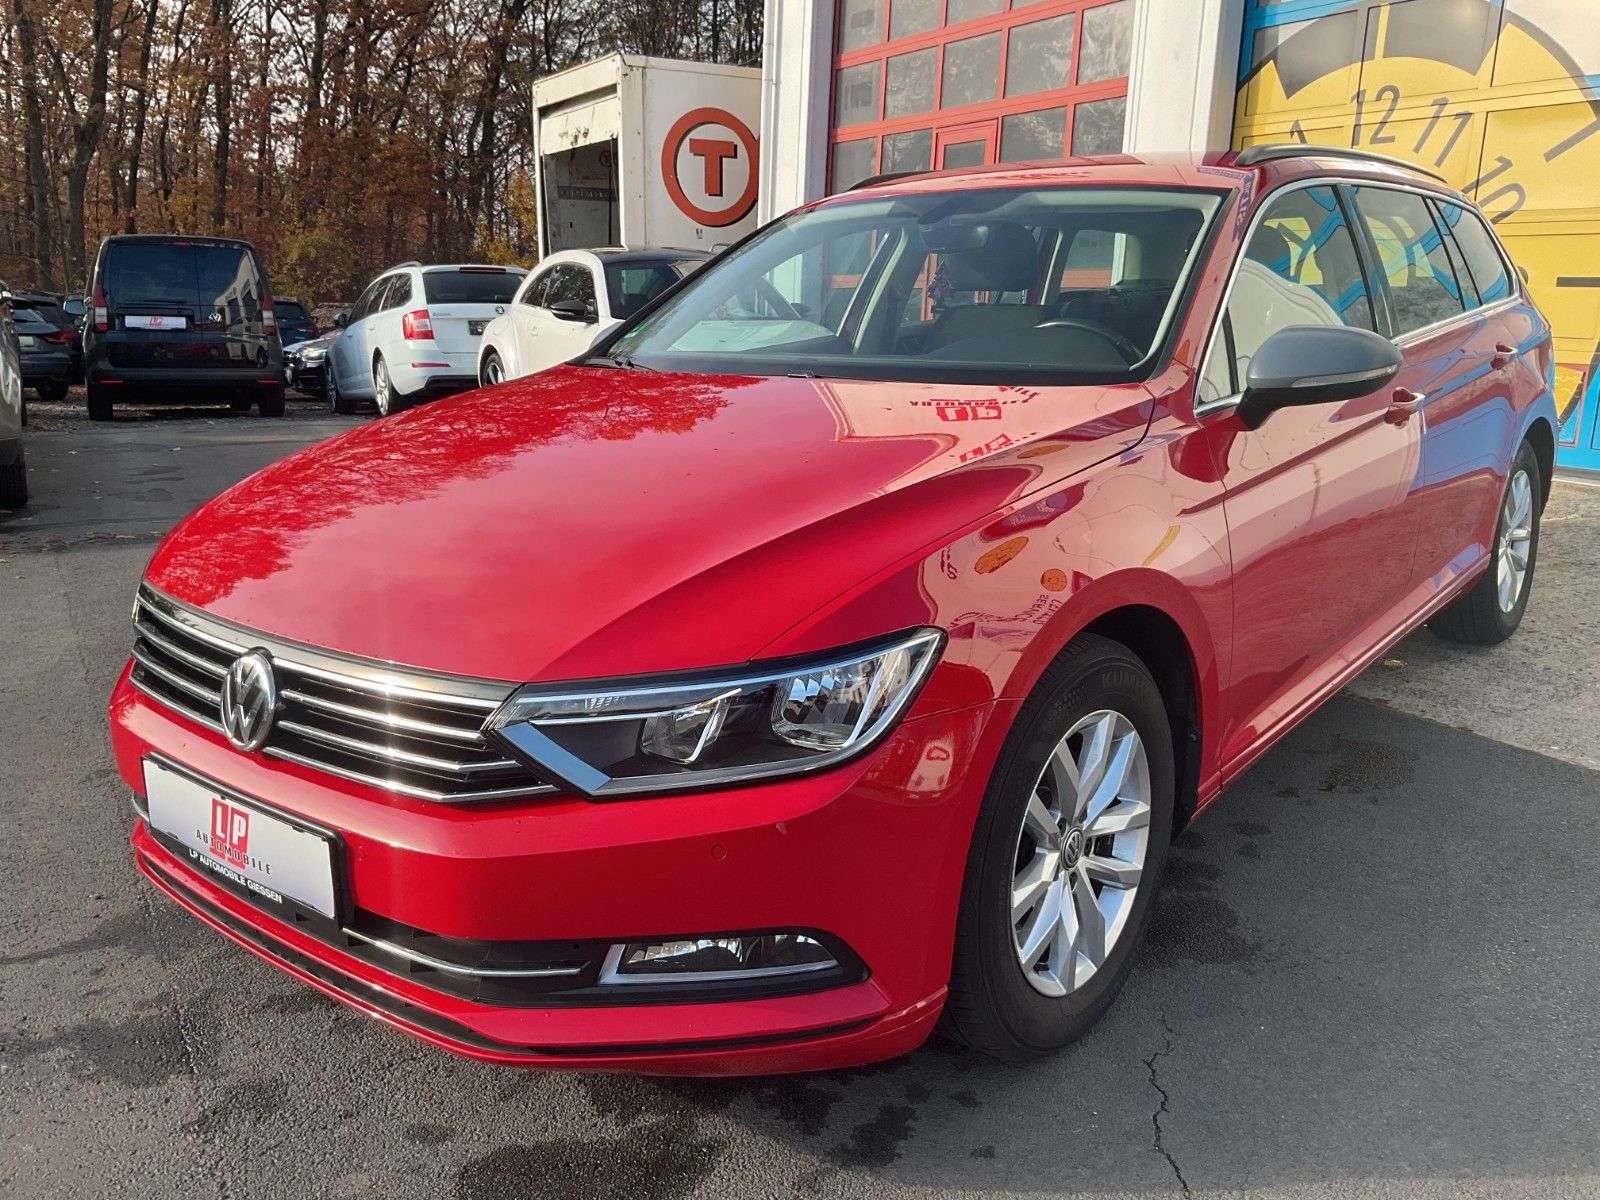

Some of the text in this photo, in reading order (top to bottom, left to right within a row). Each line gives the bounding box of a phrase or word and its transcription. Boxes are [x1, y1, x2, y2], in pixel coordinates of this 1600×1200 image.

[1350, 84, 1401, 146] 12
[1412, 96, 1475, 168] 11
[689, 138, 738, 197] T
[195, 828, 272, 876] AUTOMOBILE
[215, 804, 247, 846] LP
[189, 848, 283, 905] LP AUTOMOBILE GIESSEN
